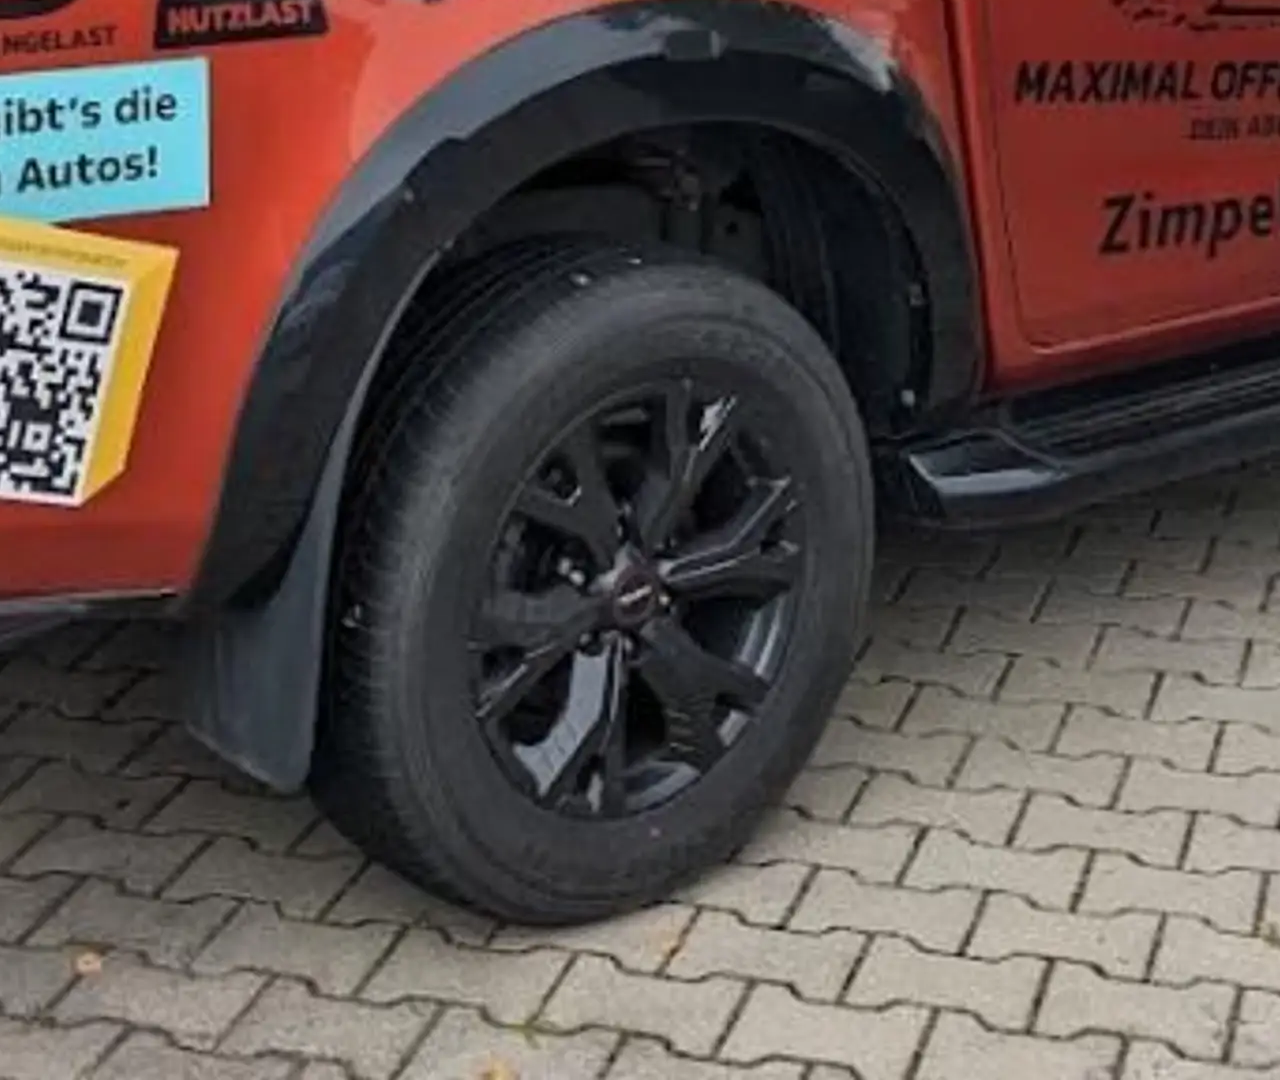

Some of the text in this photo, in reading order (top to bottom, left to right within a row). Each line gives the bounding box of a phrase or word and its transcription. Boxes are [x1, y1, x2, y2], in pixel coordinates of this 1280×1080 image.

[1014, 59, 1201, 104] MAXIMAL
[115, 85, 178, 126] die
[17, 146, 159, 193] Autos!
